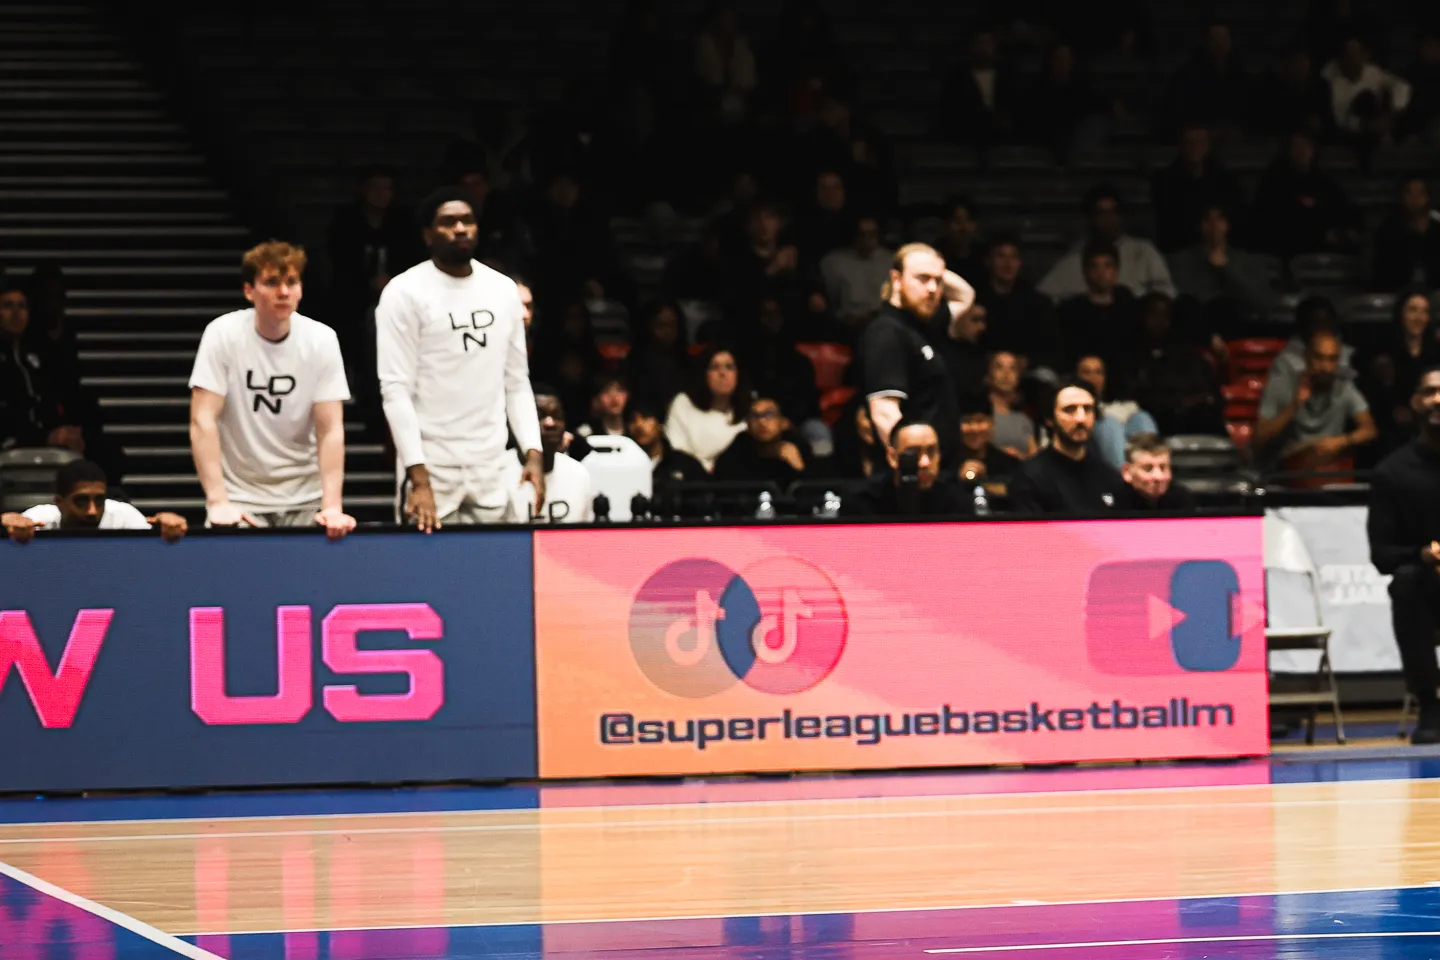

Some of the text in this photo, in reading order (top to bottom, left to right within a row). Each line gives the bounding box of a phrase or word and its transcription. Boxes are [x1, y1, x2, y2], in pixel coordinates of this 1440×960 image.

[449, 308, 495, 330] LD
[462, 332, 487, 352] N
[246, 369, 296, 396] LD
[253, 394, 282, 415] N
[189, 602, 445, 726] US
[600, 698, 1234, 749] @superleaguebasketballm
